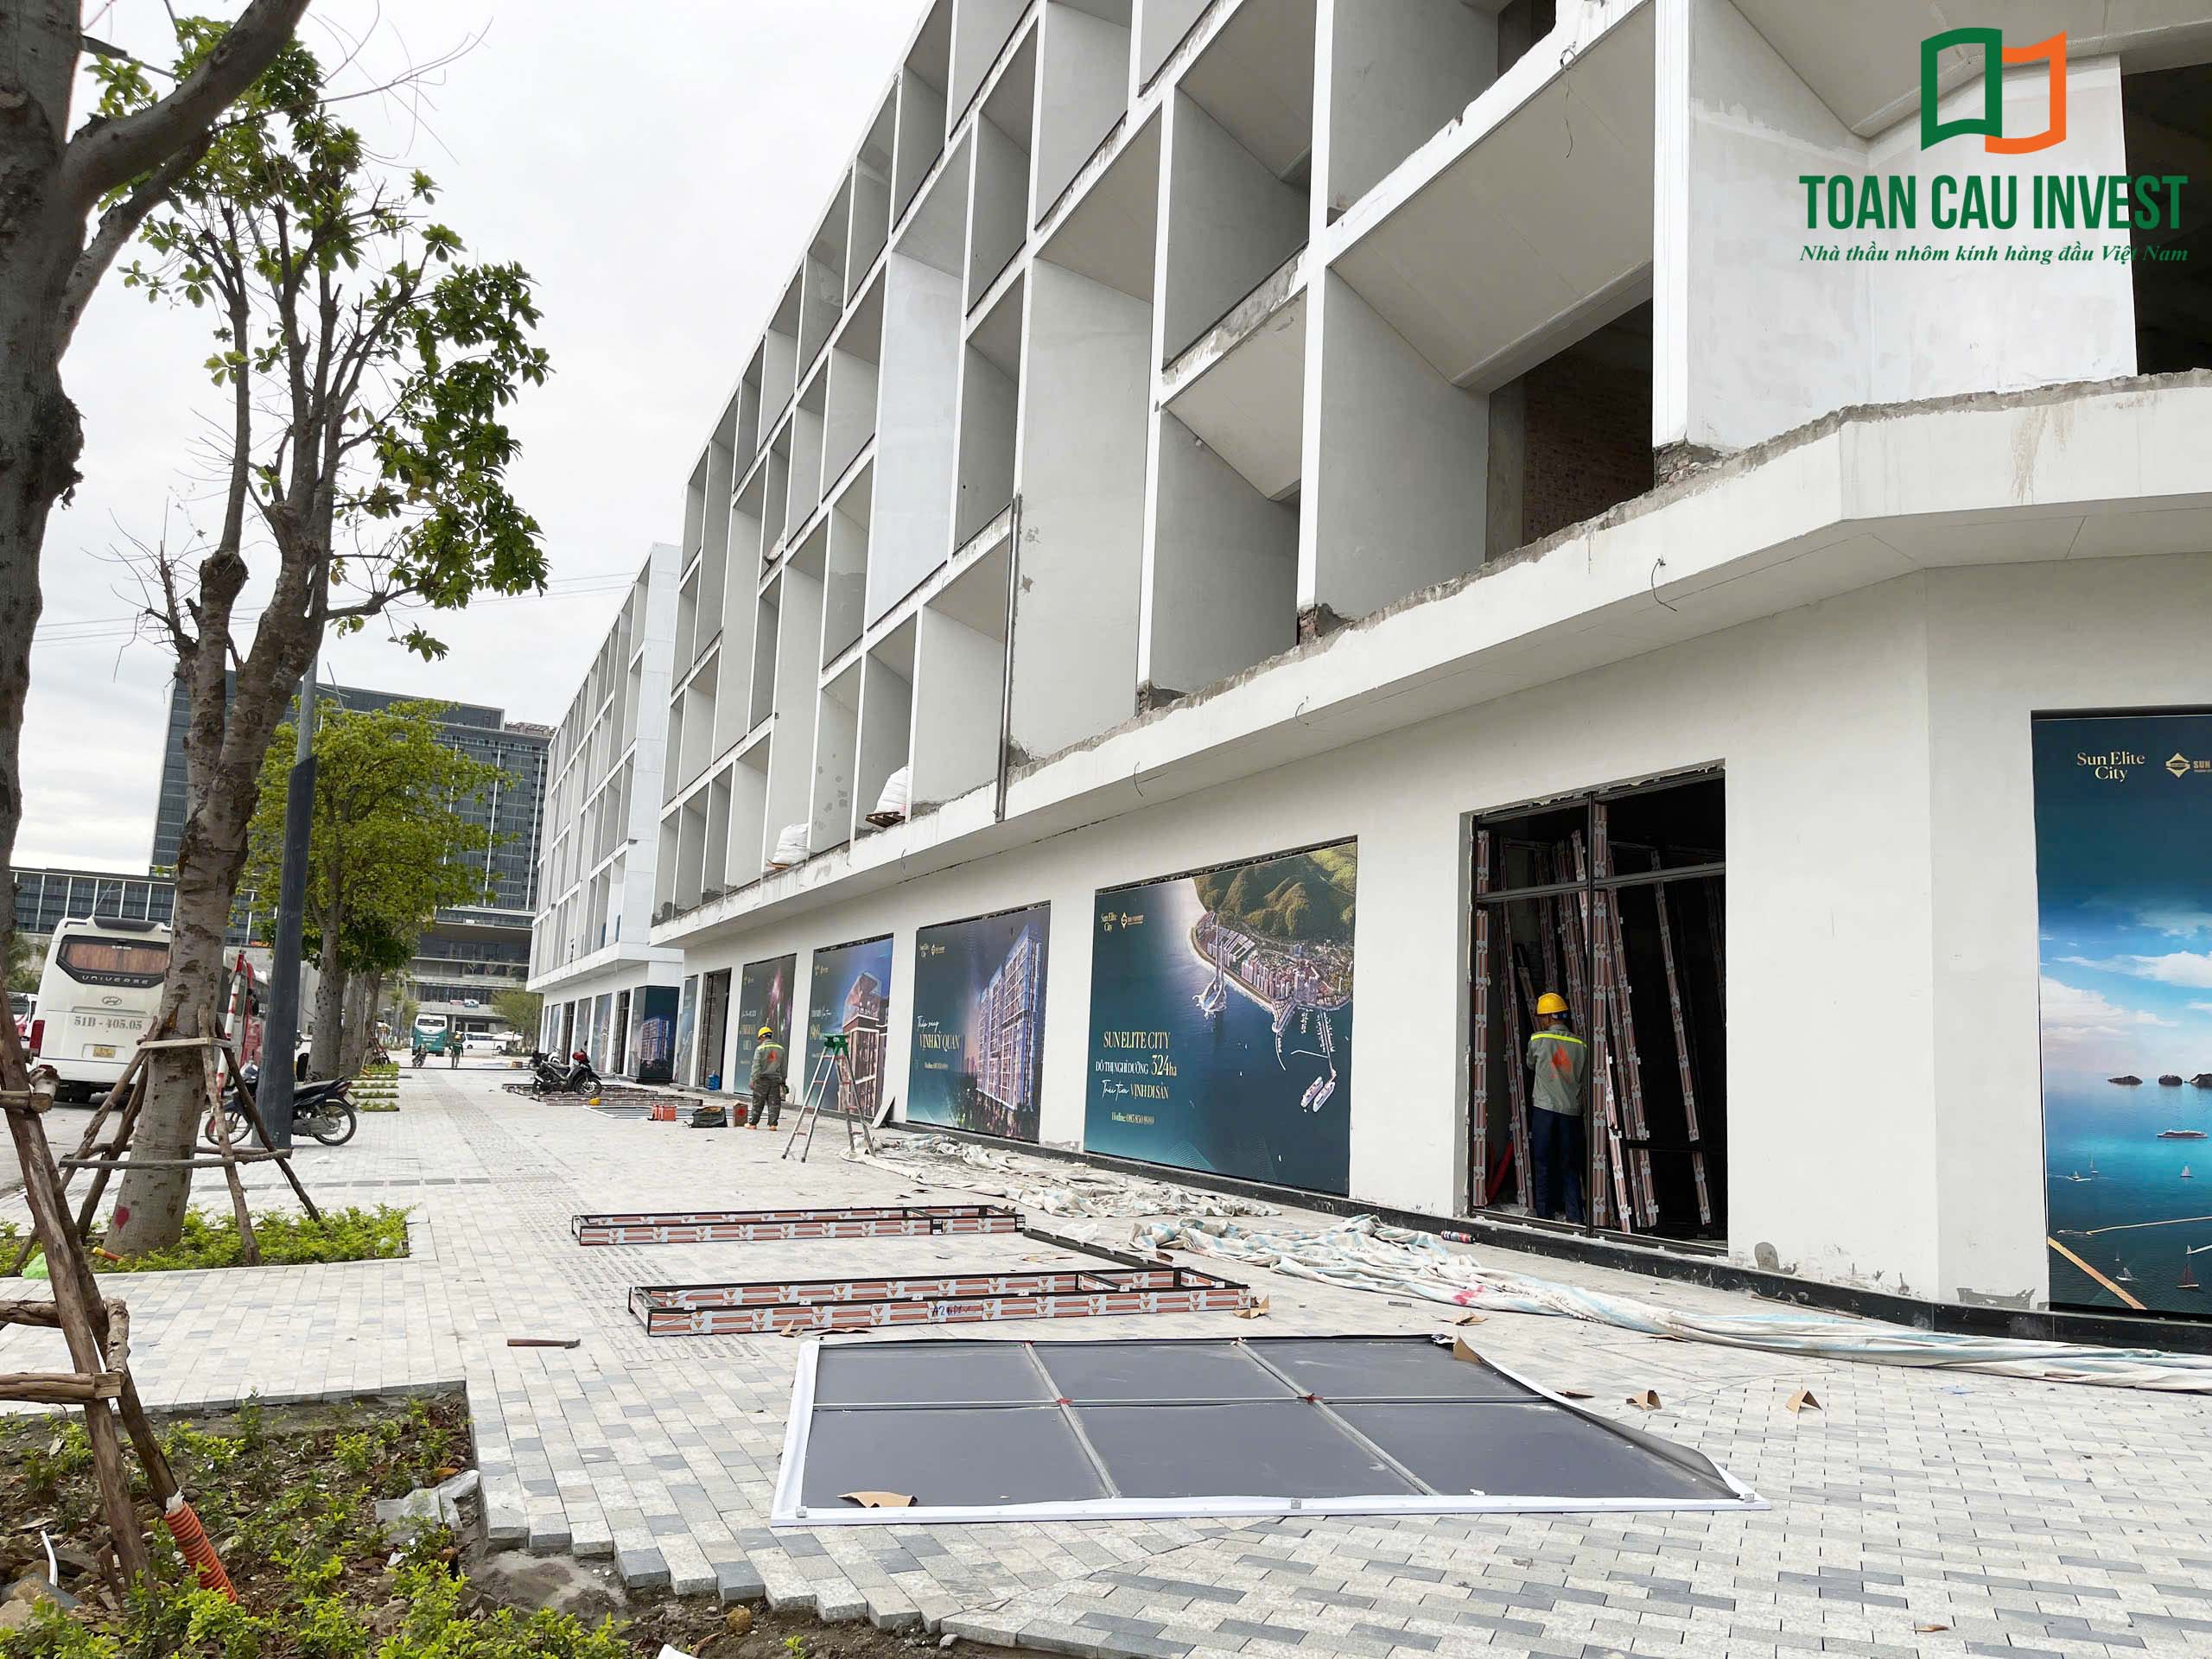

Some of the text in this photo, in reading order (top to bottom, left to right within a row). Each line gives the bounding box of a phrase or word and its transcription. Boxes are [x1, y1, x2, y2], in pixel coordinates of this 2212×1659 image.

[2076, 751, 2145, 766] Sun Elite
[2094, 766, 2128, 783] City
[82, 975, 149, 985] UNIVERSE
[74, 1015, 97, 1027] 51B
[1103, 1031, 1171, 1050] SUN ELITE CITY
